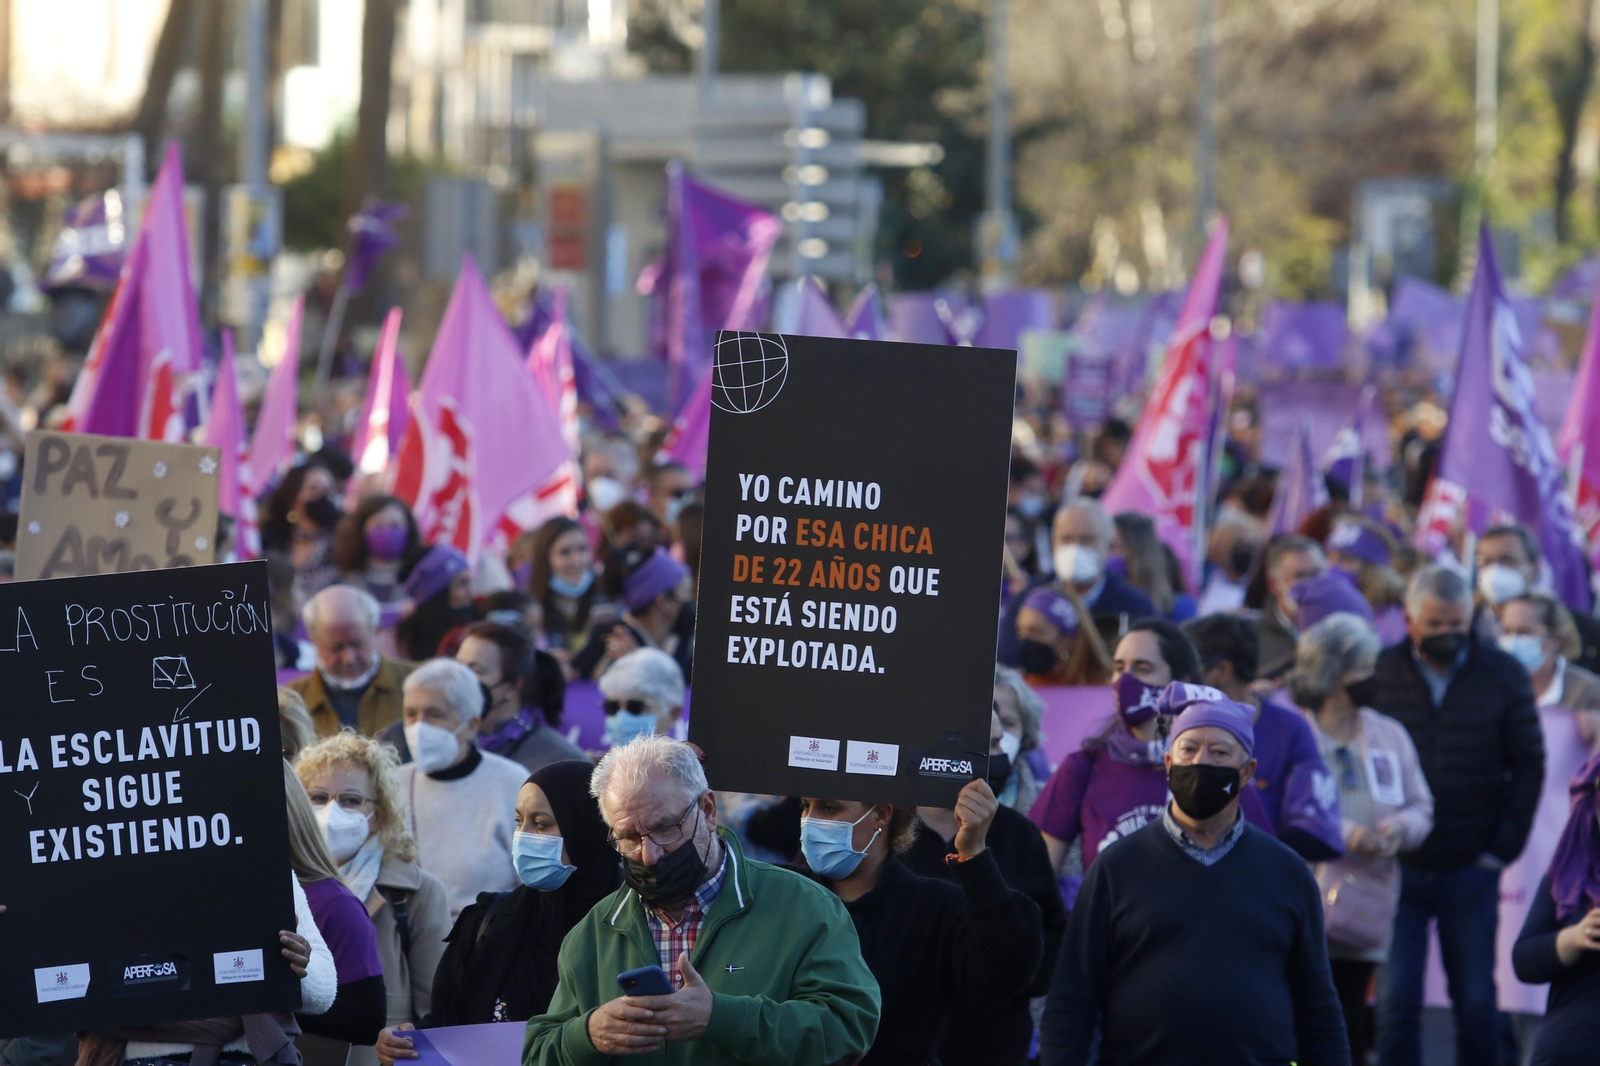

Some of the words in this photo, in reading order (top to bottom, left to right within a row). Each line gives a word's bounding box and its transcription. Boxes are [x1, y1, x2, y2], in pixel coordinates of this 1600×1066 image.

[33, 435, 138, 498] PAZ
[738, 473, 770, 503] YO
[778, 475, 882, 510] CAMINO
[154, 497, 202, 556] Y
[735, 514, 788, 544] POR
[796, 518, 845, 549] ESA
[853, 522, 934, 555] CHICA
[733, 554, 765, 584] DE
[772, 557, 802, 586] 22
[808, 555, 881, 592] AÑOS
[889, 565, 940, 596] QUE
[65, 584, 268, 646] PROSTITUCIÓN
[730, 591, 793, 626] ESTÁ
[801, 600, 897, 634] SIENDO
[727, 635, 885, 674] EXPLOTADA.
[45, 664, 104, 703] ES
[0, 737, 39, 773] LA
[919, 757, 973, 774] APERFOSA
[14, 781, 39, 815] Y
[82, 770, 183, 812] SIGUE
[29, 812, 243, 864] EXISTIENDO.
[123, 961, 177, 980] APERFOSA
